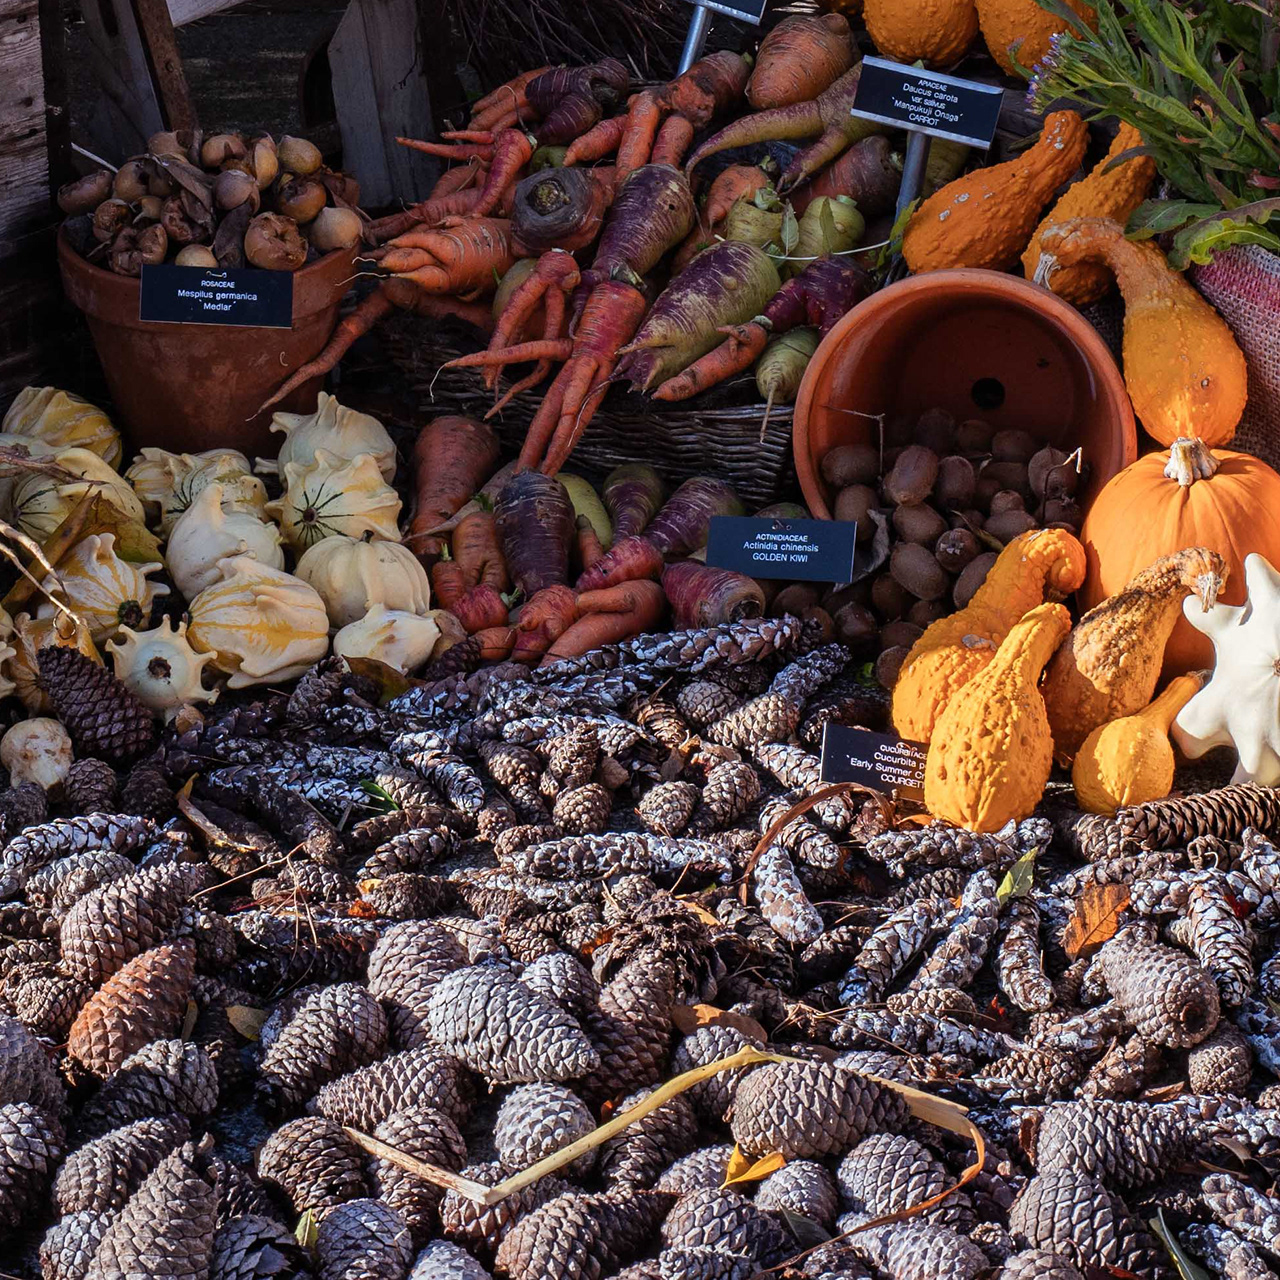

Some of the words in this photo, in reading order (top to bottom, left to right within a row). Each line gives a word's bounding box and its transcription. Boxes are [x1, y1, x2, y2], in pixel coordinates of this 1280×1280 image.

[917, 79, 948, 92] APIACEAE
[903, 83, 932, 97] Daucus
[934, 91, 958, 104] carota
[908, 113, 940, 126] CARROT
[201, 280, 235, 289] ROSACEAE
[177, 289, 213, 300] Mespilus
[215, 292, 258, 301] germanica
[755, 533, 808, 543] ACTINIDIACEAE
[743, 541, 778, 550] Actinidia
[781, 543, 819, 552] chinensis
[752, 553, 787, 562] GOLDEN
[790, 554, 808, 563] KIWI
[874, 752, 916, 768] Cucurbita
[876, 763, 912, 777] Summer
[881, 773, 925, 789] COURGETT
